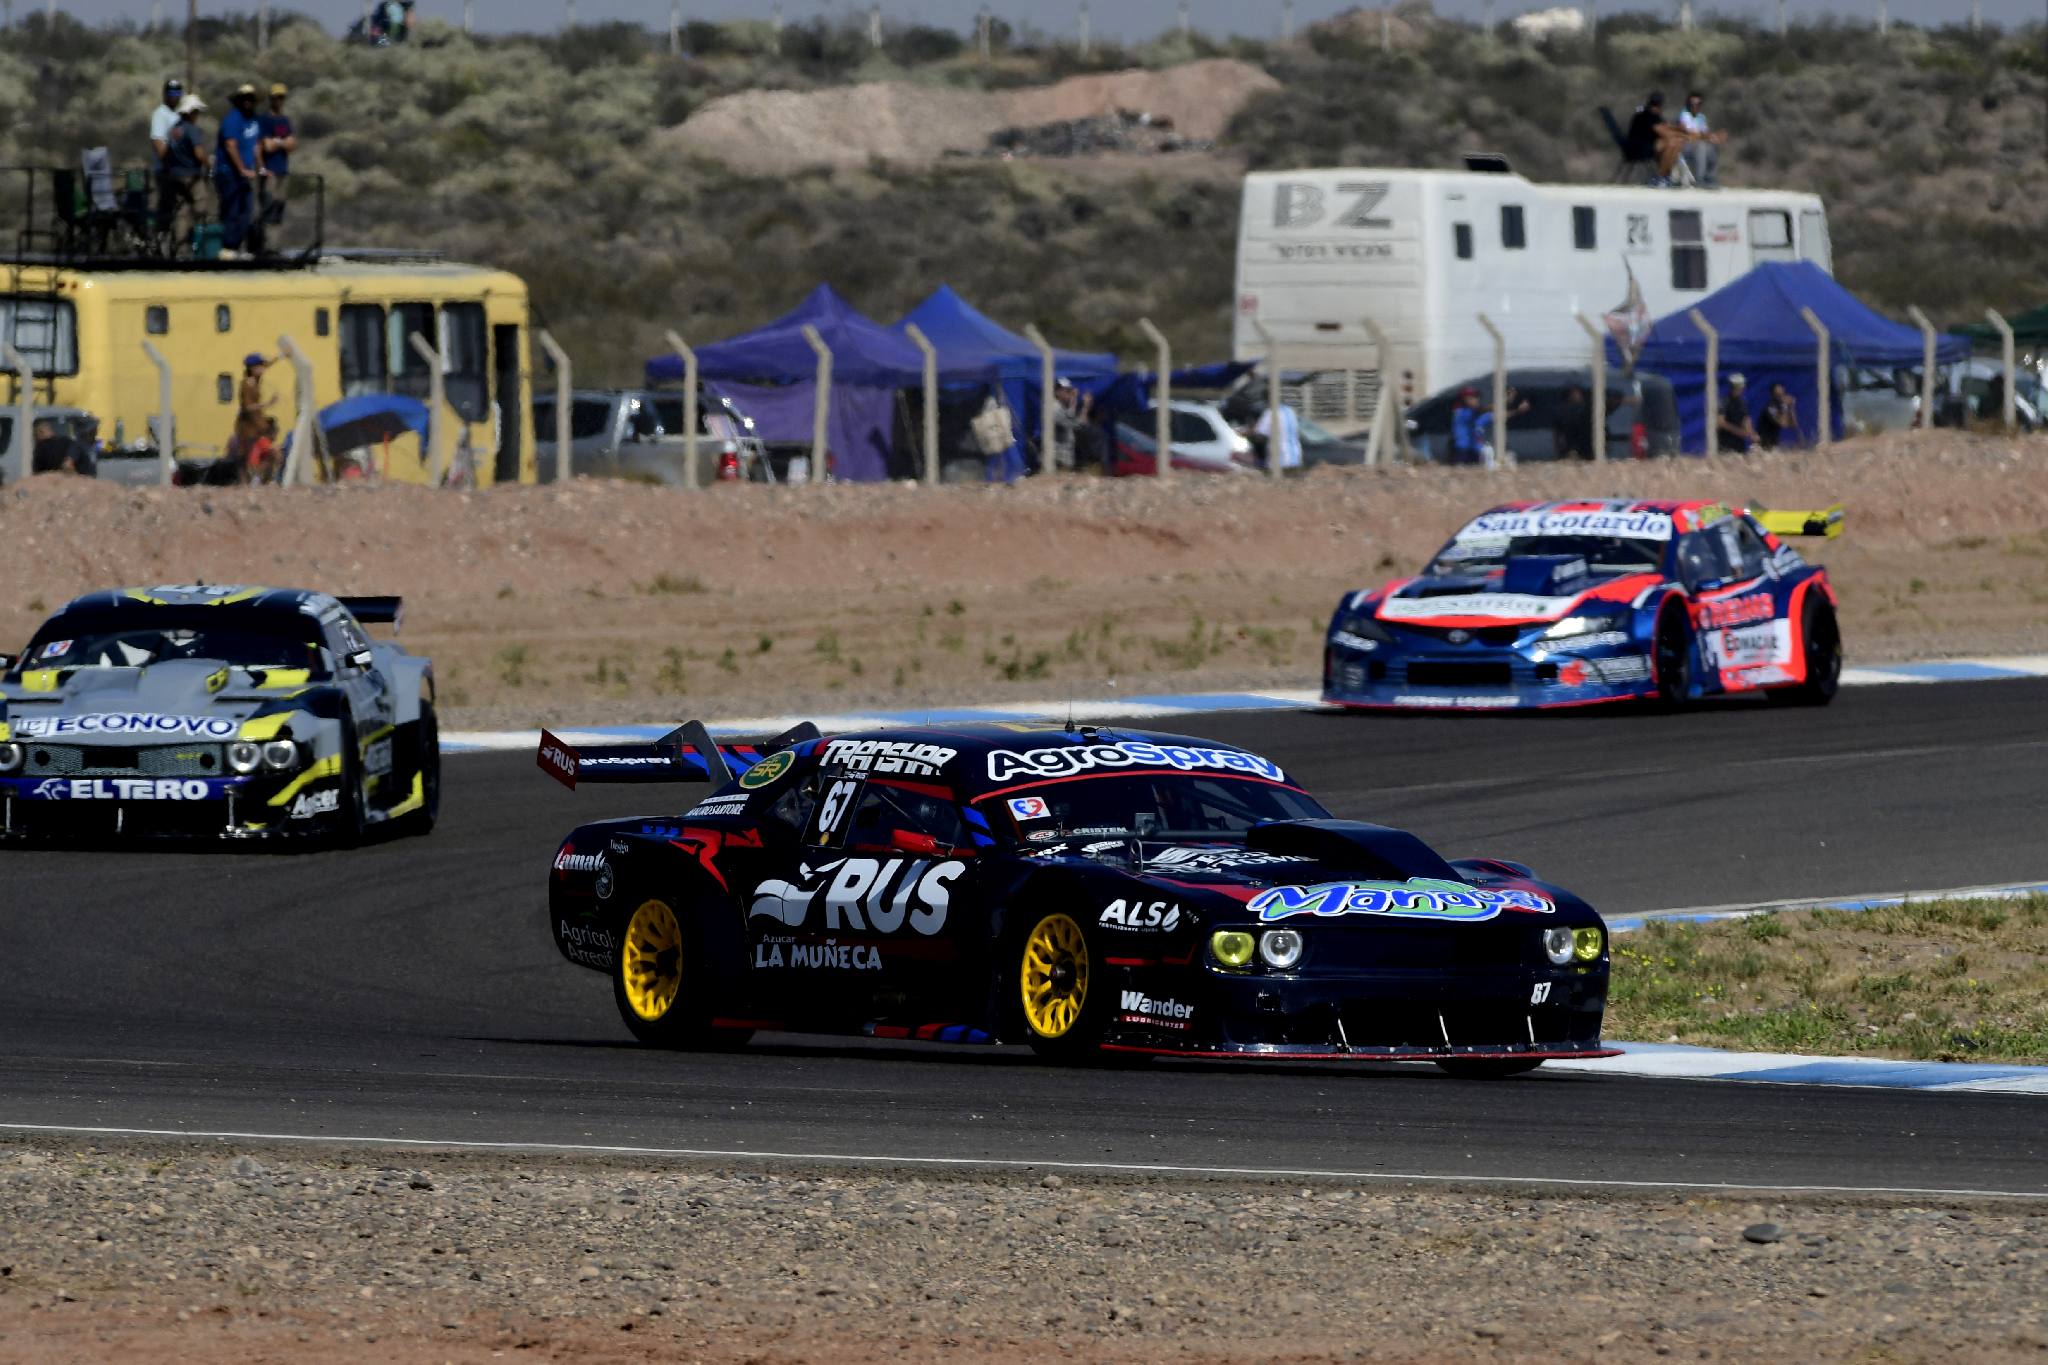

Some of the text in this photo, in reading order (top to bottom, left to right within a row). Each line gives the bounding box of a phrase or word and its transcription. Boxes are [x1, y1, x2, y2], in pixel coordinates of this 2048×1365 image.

[1274, 181, 1391, 228] BZ
[1475, 510, 1667, 534] San Gotardo
[55, 713, 235, 739] ECONOVO
[552, 751, 576, 777] RUS
[987, 743, 1285, 781] AgroSpray
[70, 779, 209, 800] EL TERO
[818, 780, 857, 832] 67
[825, 858, 966, 936] RUS
[760, 934, 797, 945] Azucar
[755, 938, 884, 971] LA MUÑECA
[1120, 989, 1195, 1020] Wander
[1530, 981, 1552, 1004] 67
